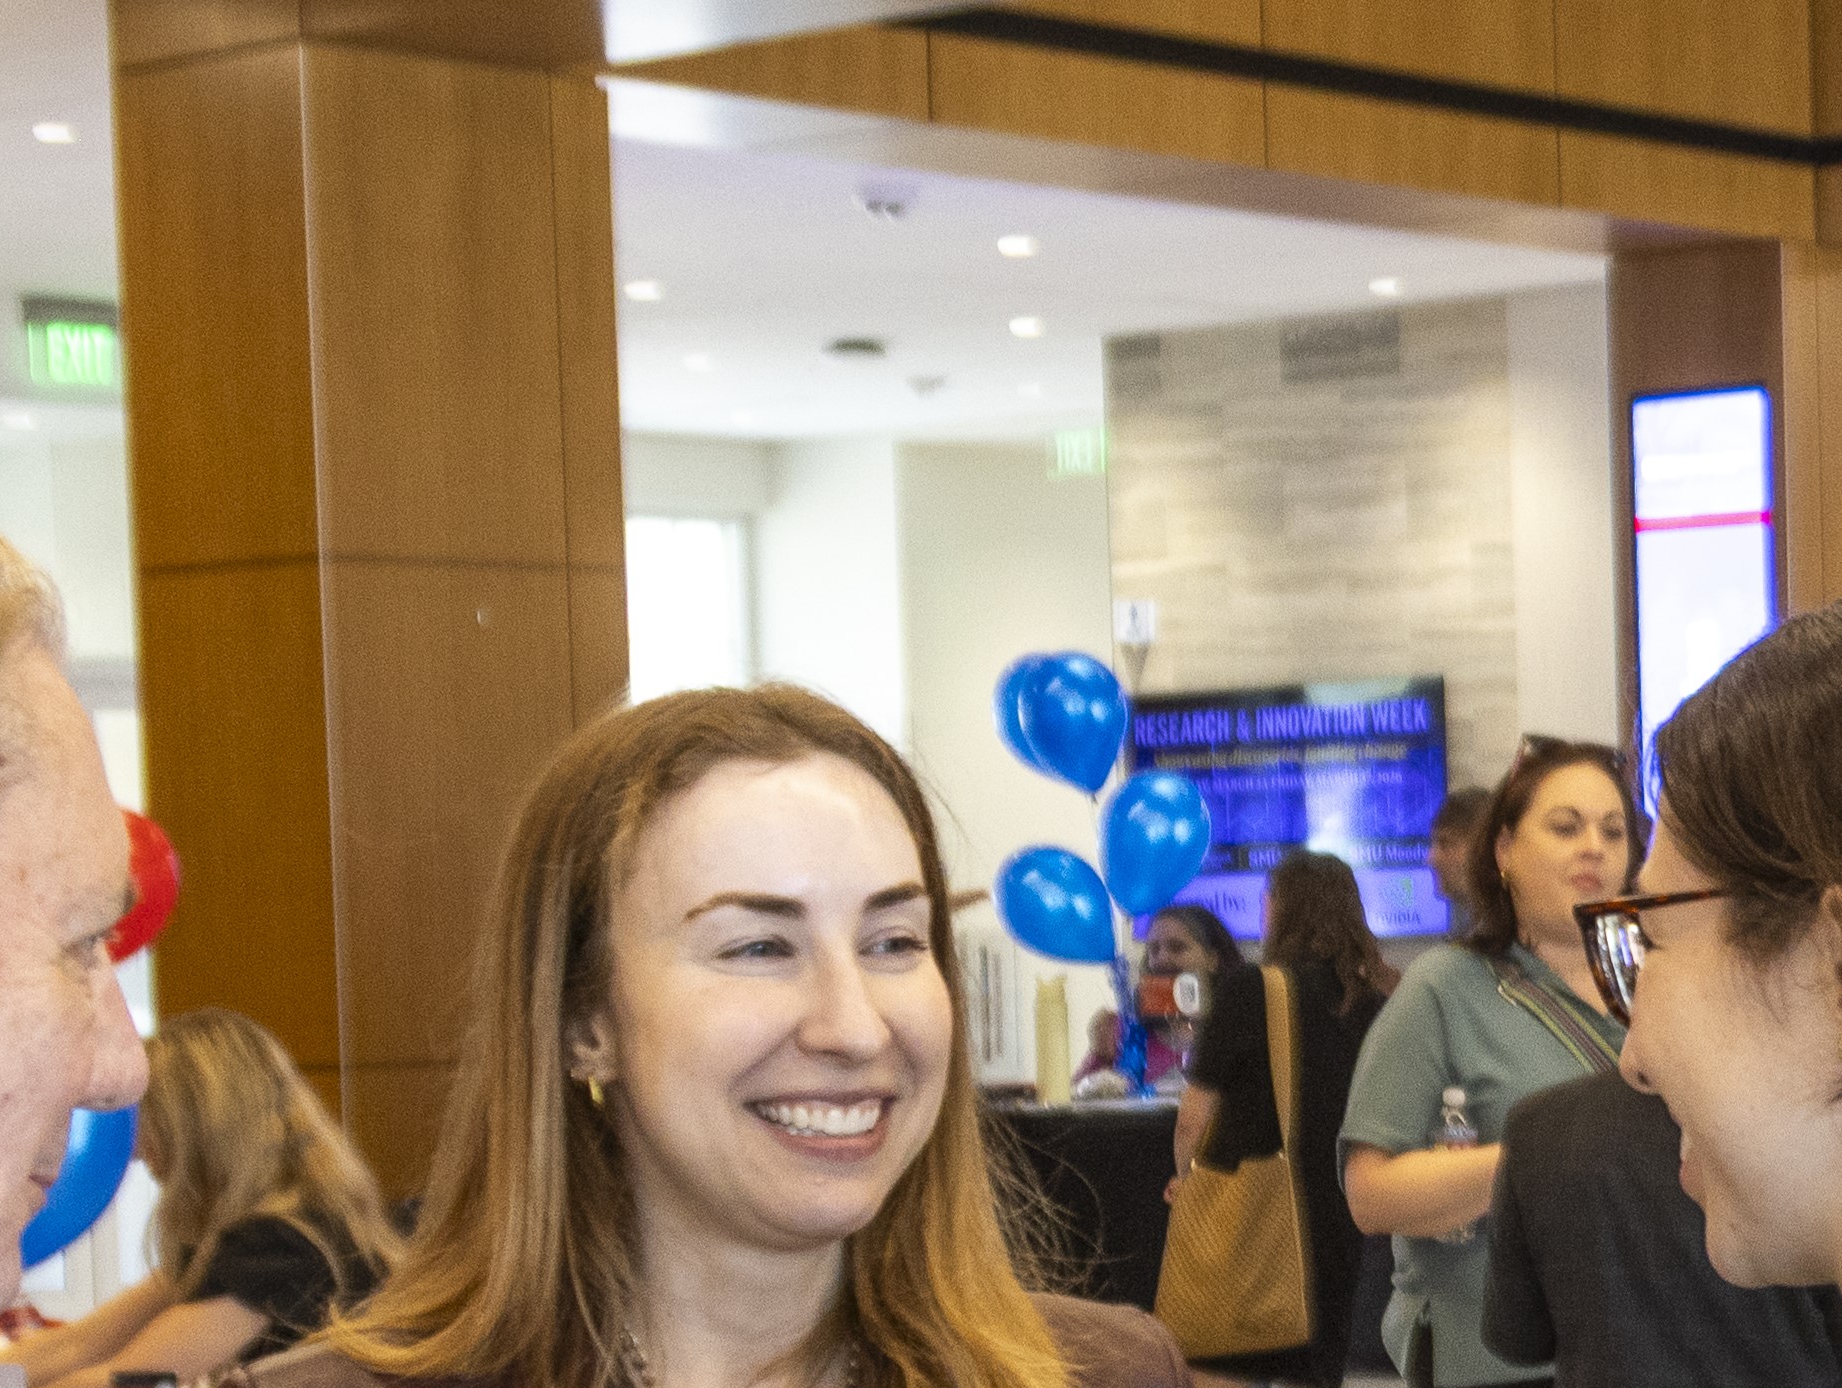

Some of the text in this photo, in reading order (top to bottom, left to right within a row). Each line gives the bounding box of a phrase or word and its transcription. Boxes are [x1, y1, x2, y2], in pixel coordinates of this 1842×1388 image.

[46, 322, 113, 385] EXIT
[1134, 697, 1428, 746] RESEARCH & INNOVATION WEEK
